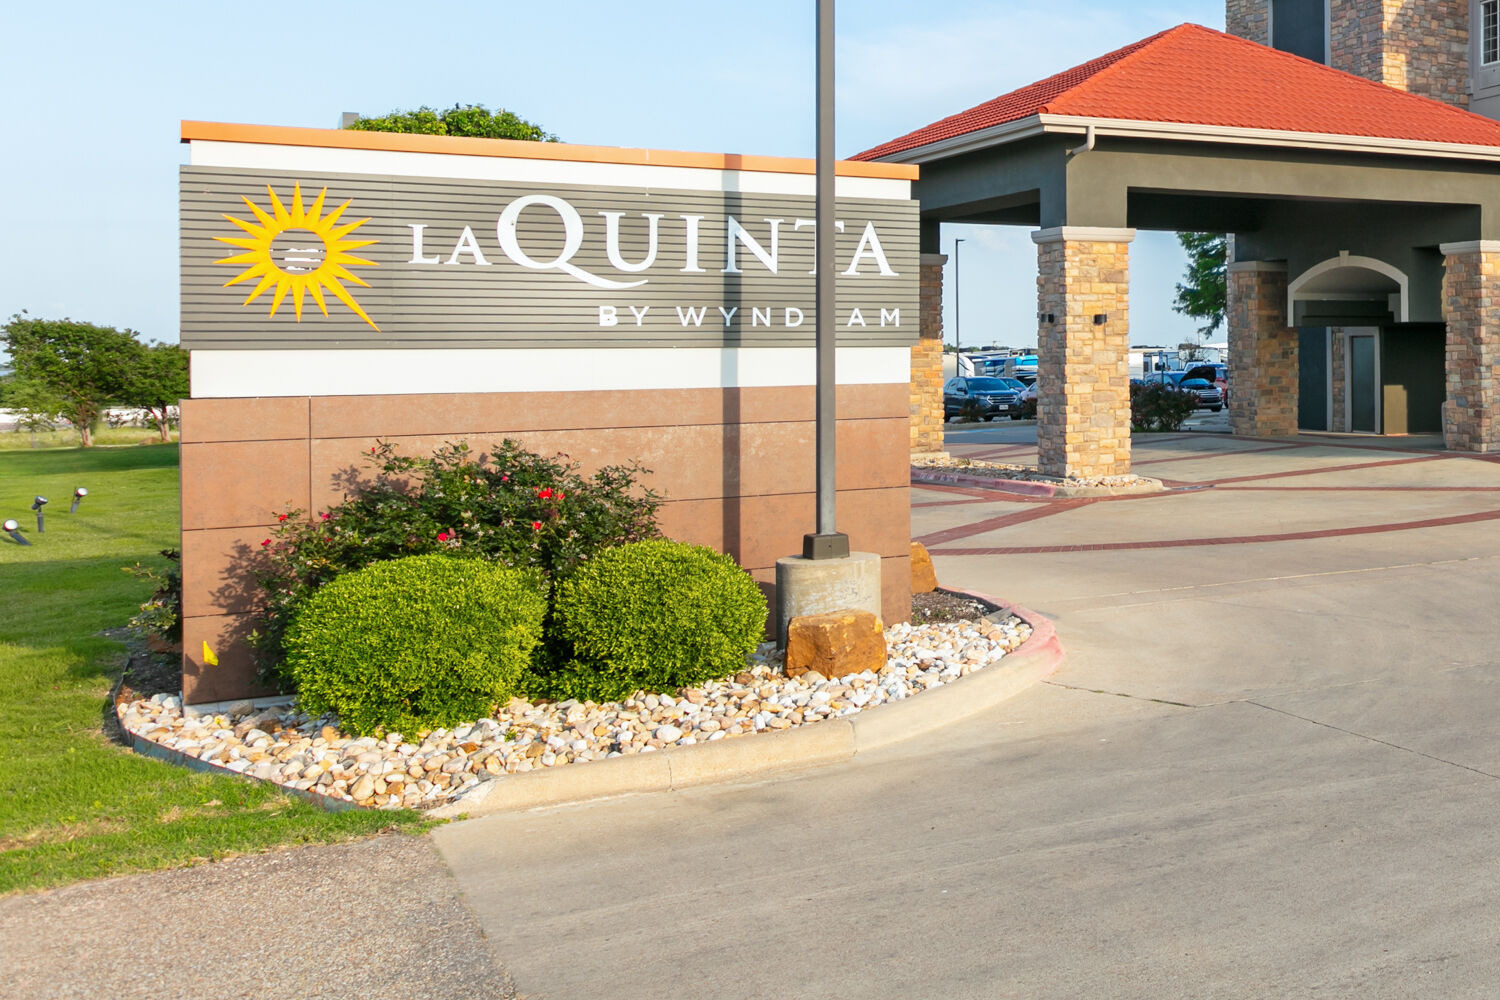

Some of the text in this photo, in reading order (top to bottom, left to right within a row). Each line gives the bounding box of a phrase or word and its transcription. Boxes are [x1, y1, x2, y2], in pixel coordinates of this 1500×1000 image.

[407, 223, 493, 266] LA
[598, 305, 900, 328] BY WYNDAM
